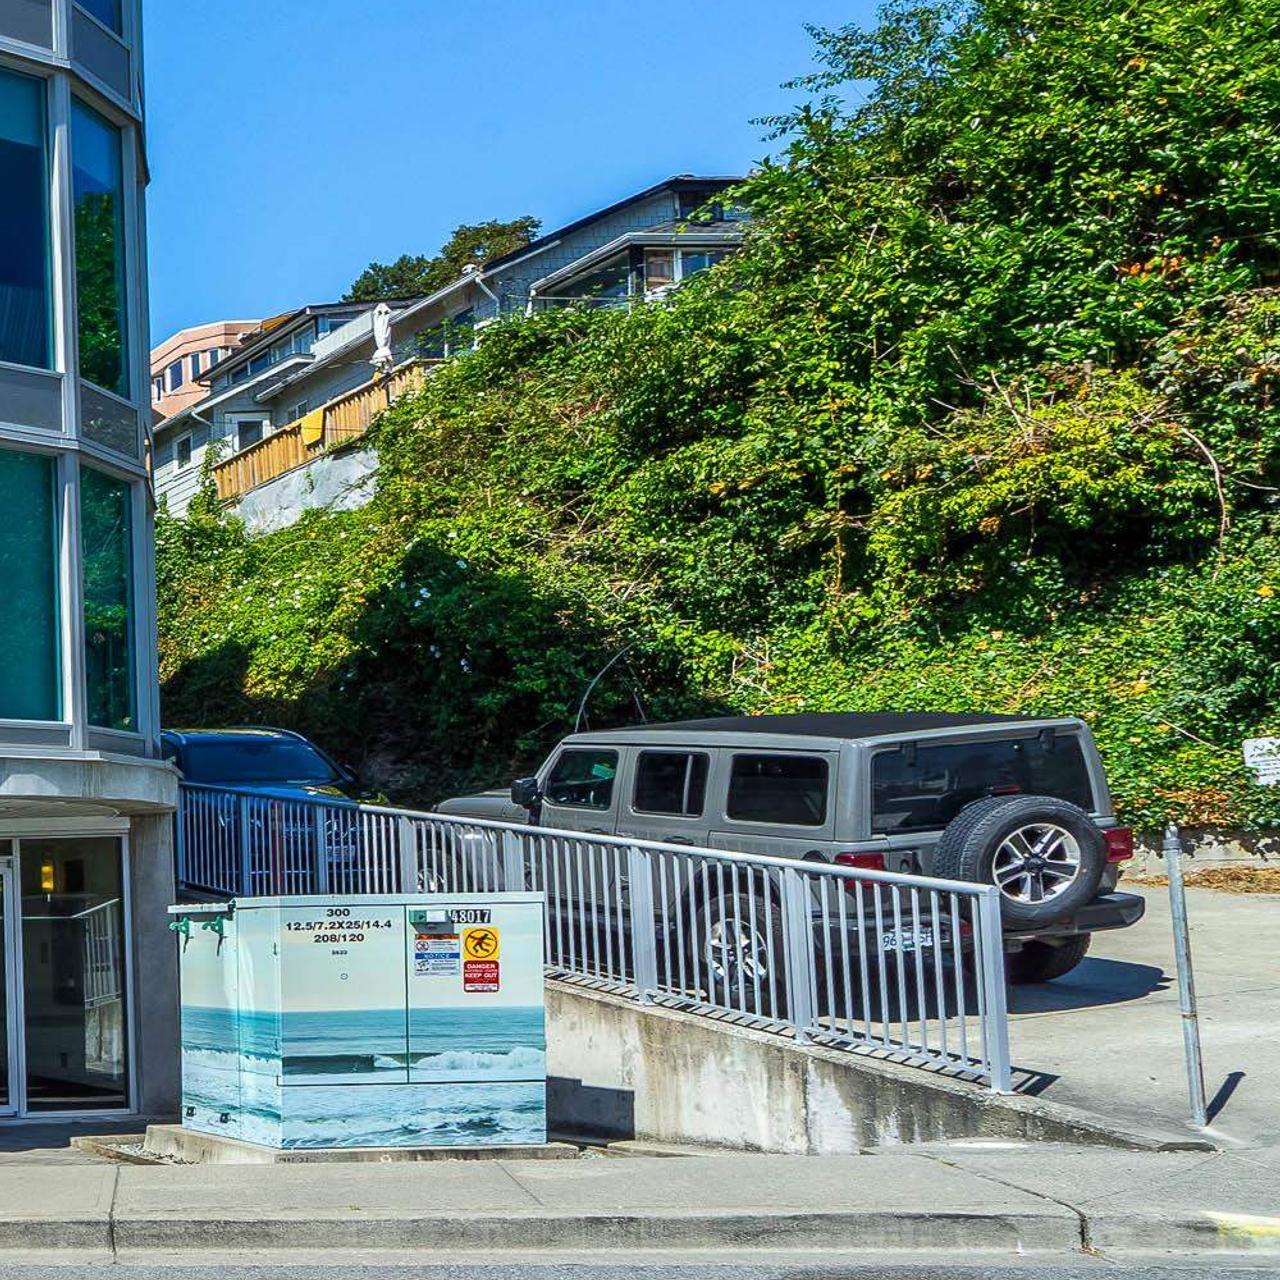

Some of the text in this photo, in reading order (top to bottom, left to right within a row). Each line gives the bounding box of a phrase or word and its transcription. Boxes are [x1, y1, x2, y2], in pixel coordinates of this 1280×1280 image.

[326, 908, 351, 918] 300
[450, 910, 490, 923] 48017
[314, 933, 365, 943] 208/120
